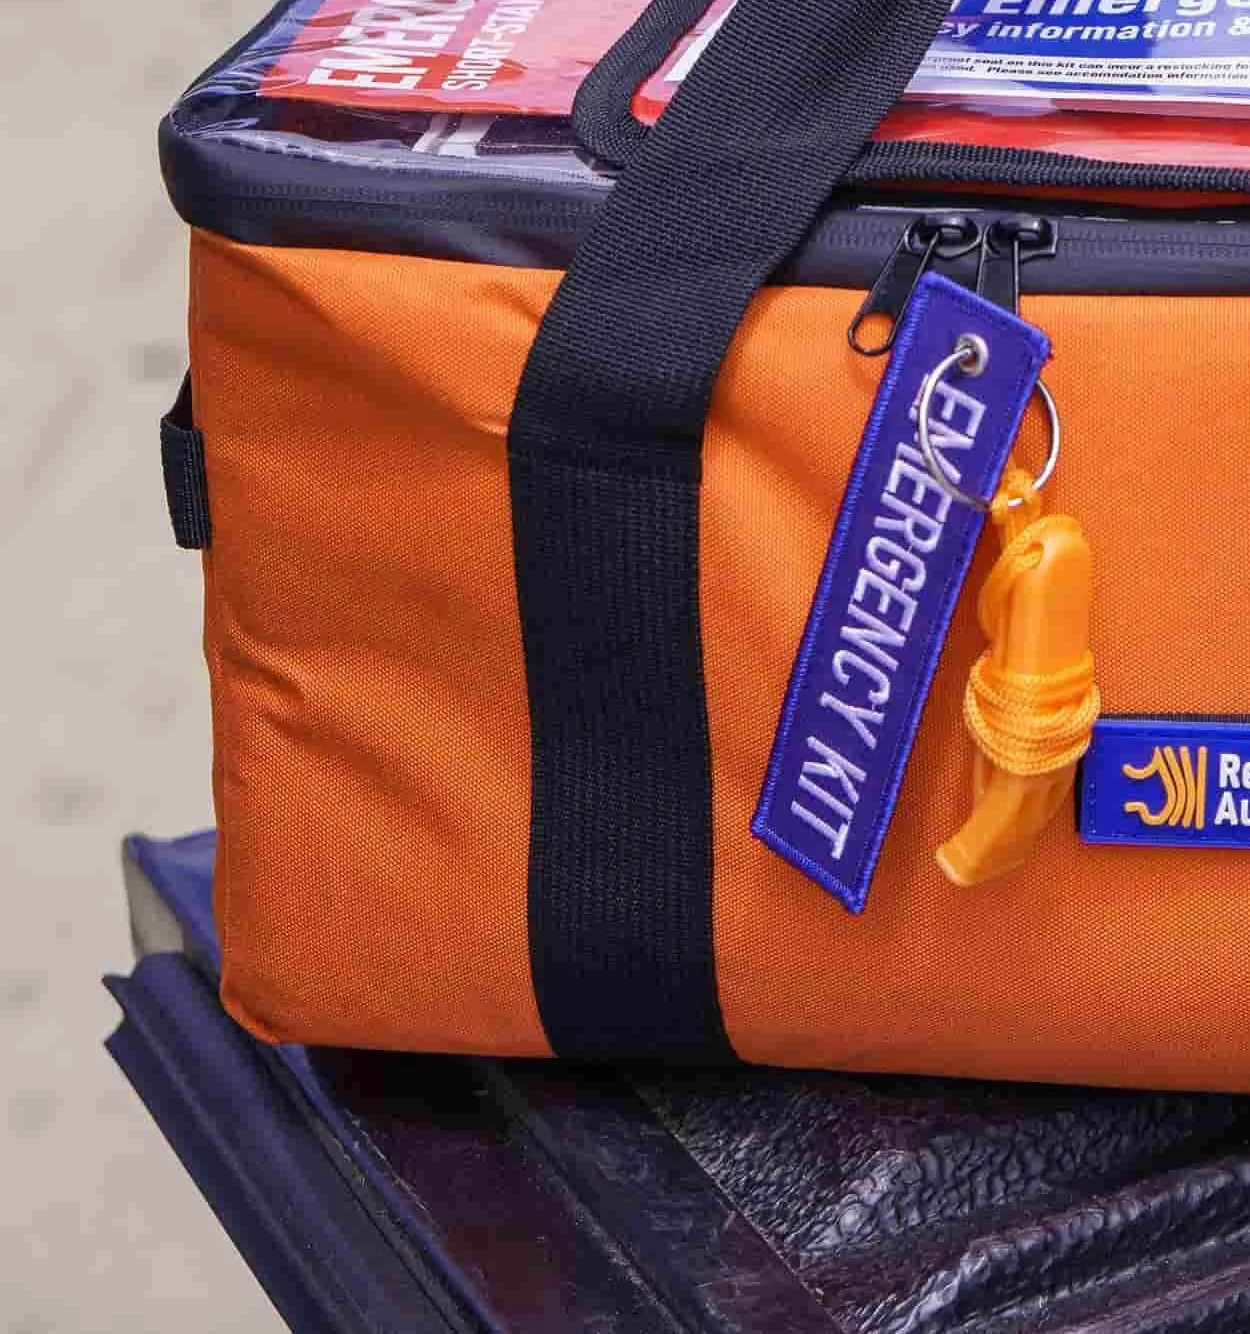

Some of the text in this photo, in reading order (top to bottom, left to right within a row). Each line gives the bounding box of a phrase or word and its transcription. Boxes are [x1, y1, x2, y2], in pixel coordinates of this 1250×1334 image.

[985, 19, 1217, 40] information
[792, 373, 986, 860] EMERGENCY KIT
